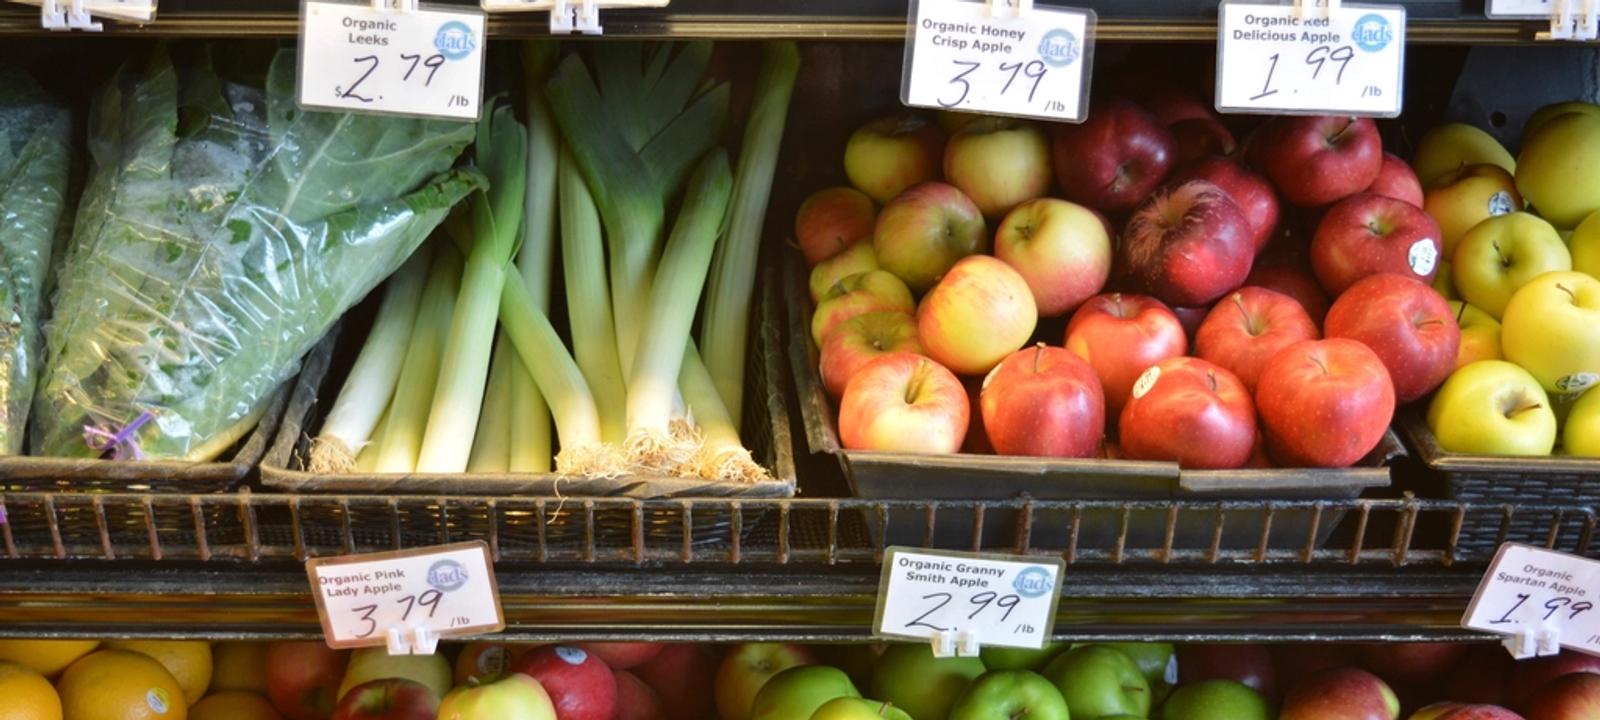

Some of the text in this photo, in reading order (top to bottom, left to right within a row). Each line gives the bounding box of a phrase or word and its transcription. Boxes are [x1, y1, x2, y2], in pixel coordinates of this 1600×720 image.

[342, 16, 398, 32] Organic
[1245, 14, 1299, 28] Organic
[922, 18, 1026, 42] Organic Honey
[1233, 29, 1341, 44] Delicious Apple
[348, 33, 389, 46] Leeks
[932, 35, 1012, 54] Crisp Apple
[1361, 85, 1382, 98] /lb
[448, 95, 469, 108] /lb
[1043, 100, 1065, 113] /lb
[899, 557, 1006, 578] Organic Granny
[1523, 564, 1574, 581] Organic
[319, 568, 406, 585] Organic Pink
[906, 571, 989, 588] Smith Apple
[1496, 571, 1586, 597] Spartan Apple
[327, 582, 402, 598] Lady Apple
[450, 616, 470, 628] /lb
[1014, 624, 1035, 634] /lb
